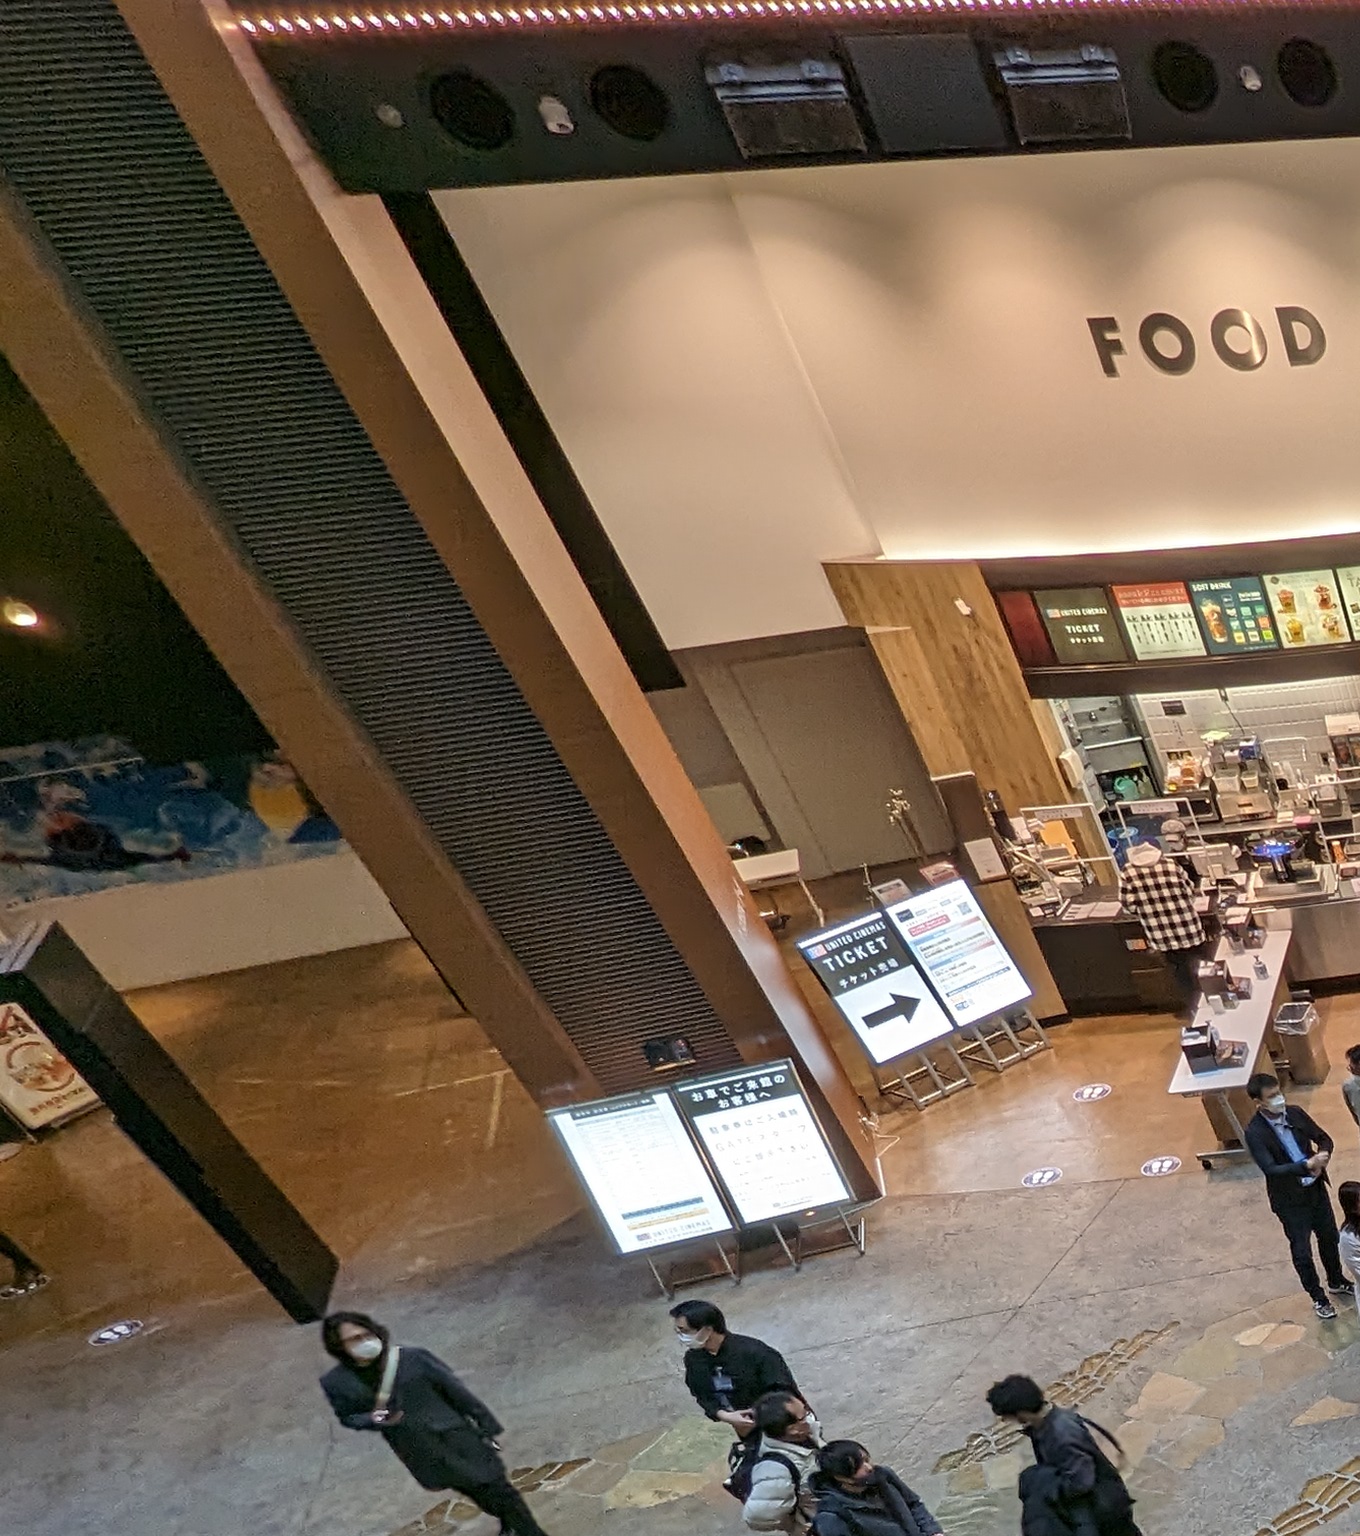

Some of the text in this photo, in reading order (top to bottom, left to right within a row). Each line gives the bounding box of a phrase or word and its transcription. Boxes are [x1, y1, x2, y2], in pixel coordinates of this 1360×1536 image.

[1087, 306, 1328, 378] FOOD
[1065, 623, 1101, 634] TICKET
[825, 921, 886, 952] UNITED CINEMAS
[822, 936, 890, 972] TICKET
[839, 957, 900, 989] チケット売場
[692, 1074, 786, 1102] お車でご来館の
[718, 1090, 772, 1109] お客様へ
